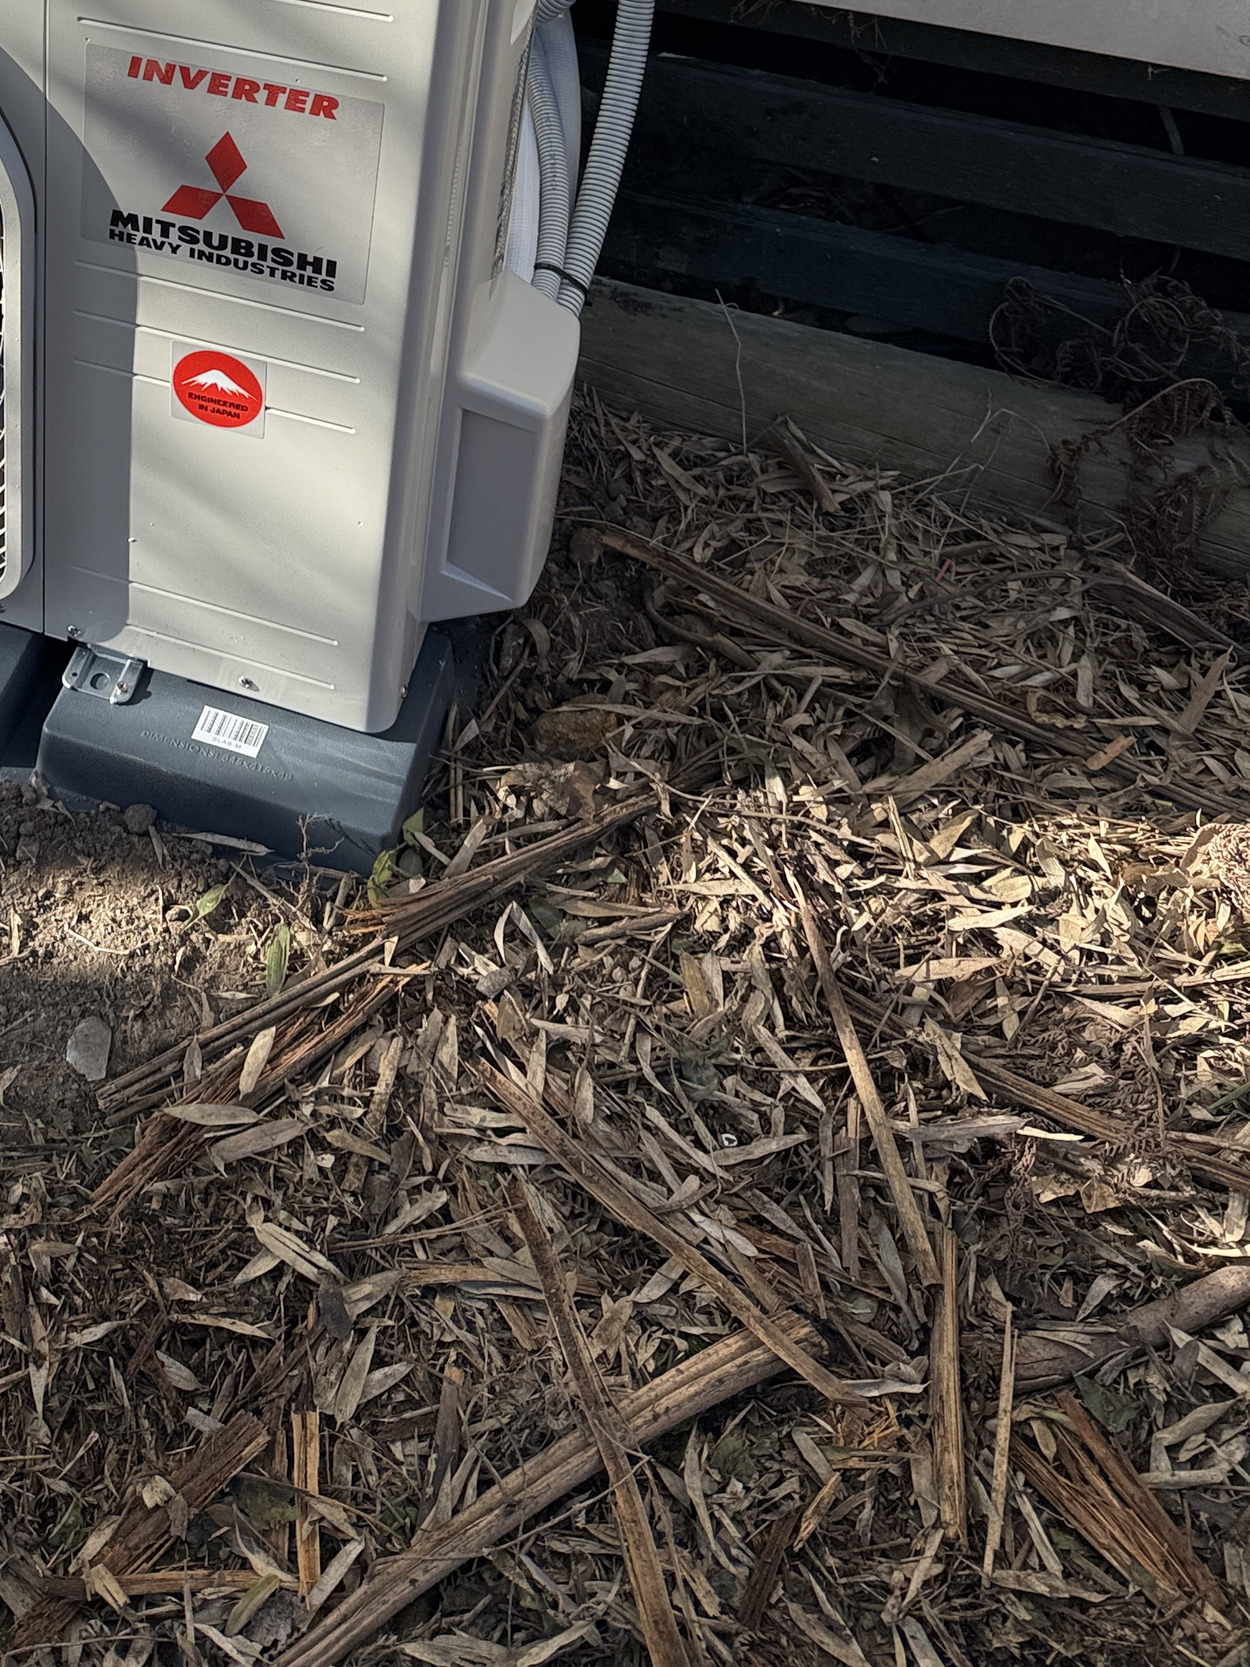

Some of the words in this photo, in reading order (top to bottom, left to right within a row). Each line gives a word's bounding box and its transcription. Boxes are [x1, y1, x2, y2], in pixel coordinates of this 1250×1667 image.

[127, 55, 340, 121] INVERTER
[108, 228, 182, 255] HEAVY
[188, 247, 336, 292] INDUSTRIES
[109, 208, 337, 279] MITSUBISHI
[187, 391, 249, 412] ENGINEERED
[198, 403, 208, 412] IN
[210, 406, 241, 420] JAPAN
